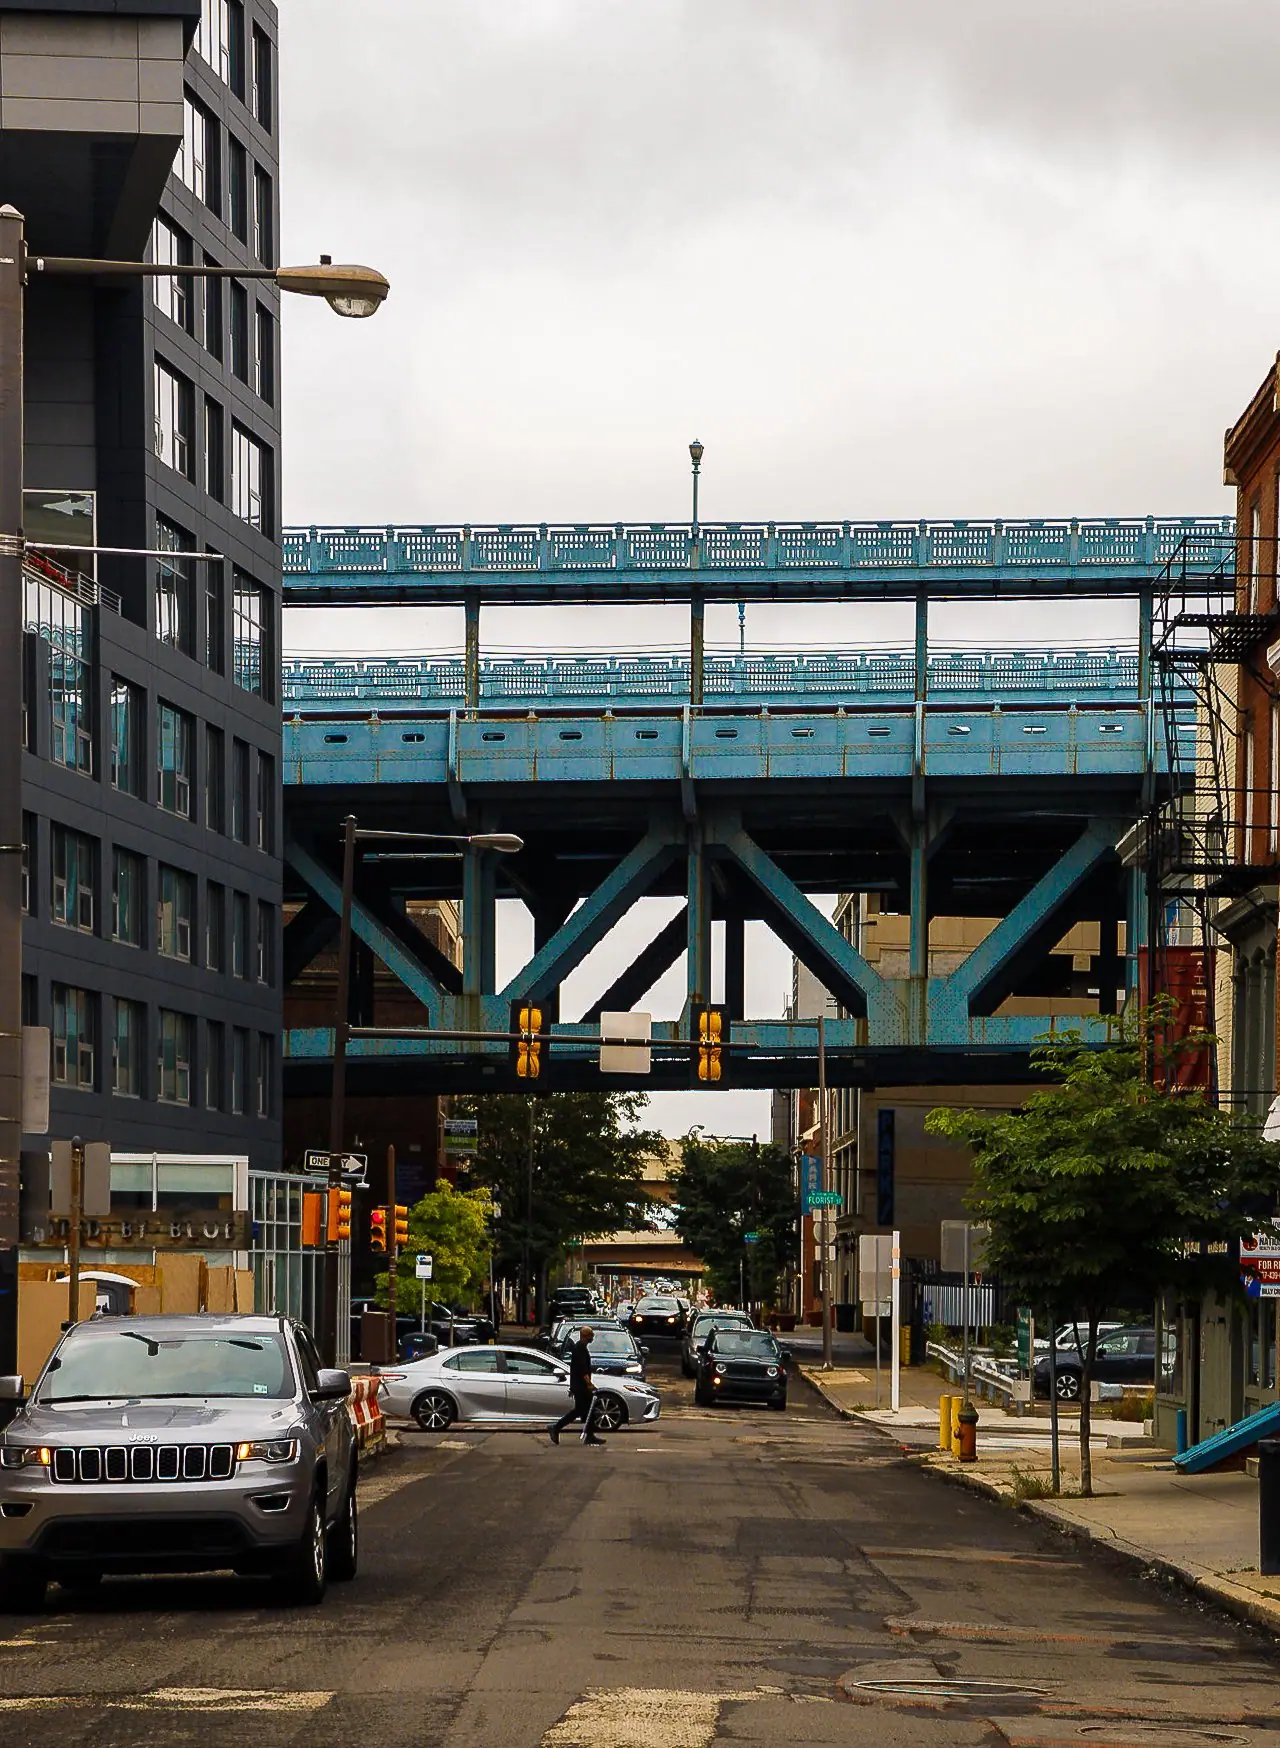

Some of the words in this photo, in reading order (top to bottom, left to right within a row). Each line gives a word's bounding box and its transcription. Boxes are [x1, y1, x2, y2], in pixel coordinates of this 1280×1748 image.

[311, 1156, 329, 1166] ONE
[808, 1196, 834, 1205] FLORIST
[1258, 1260, 1272, 1270] FOR
[128, 1433, 159, 1443] Jeep
